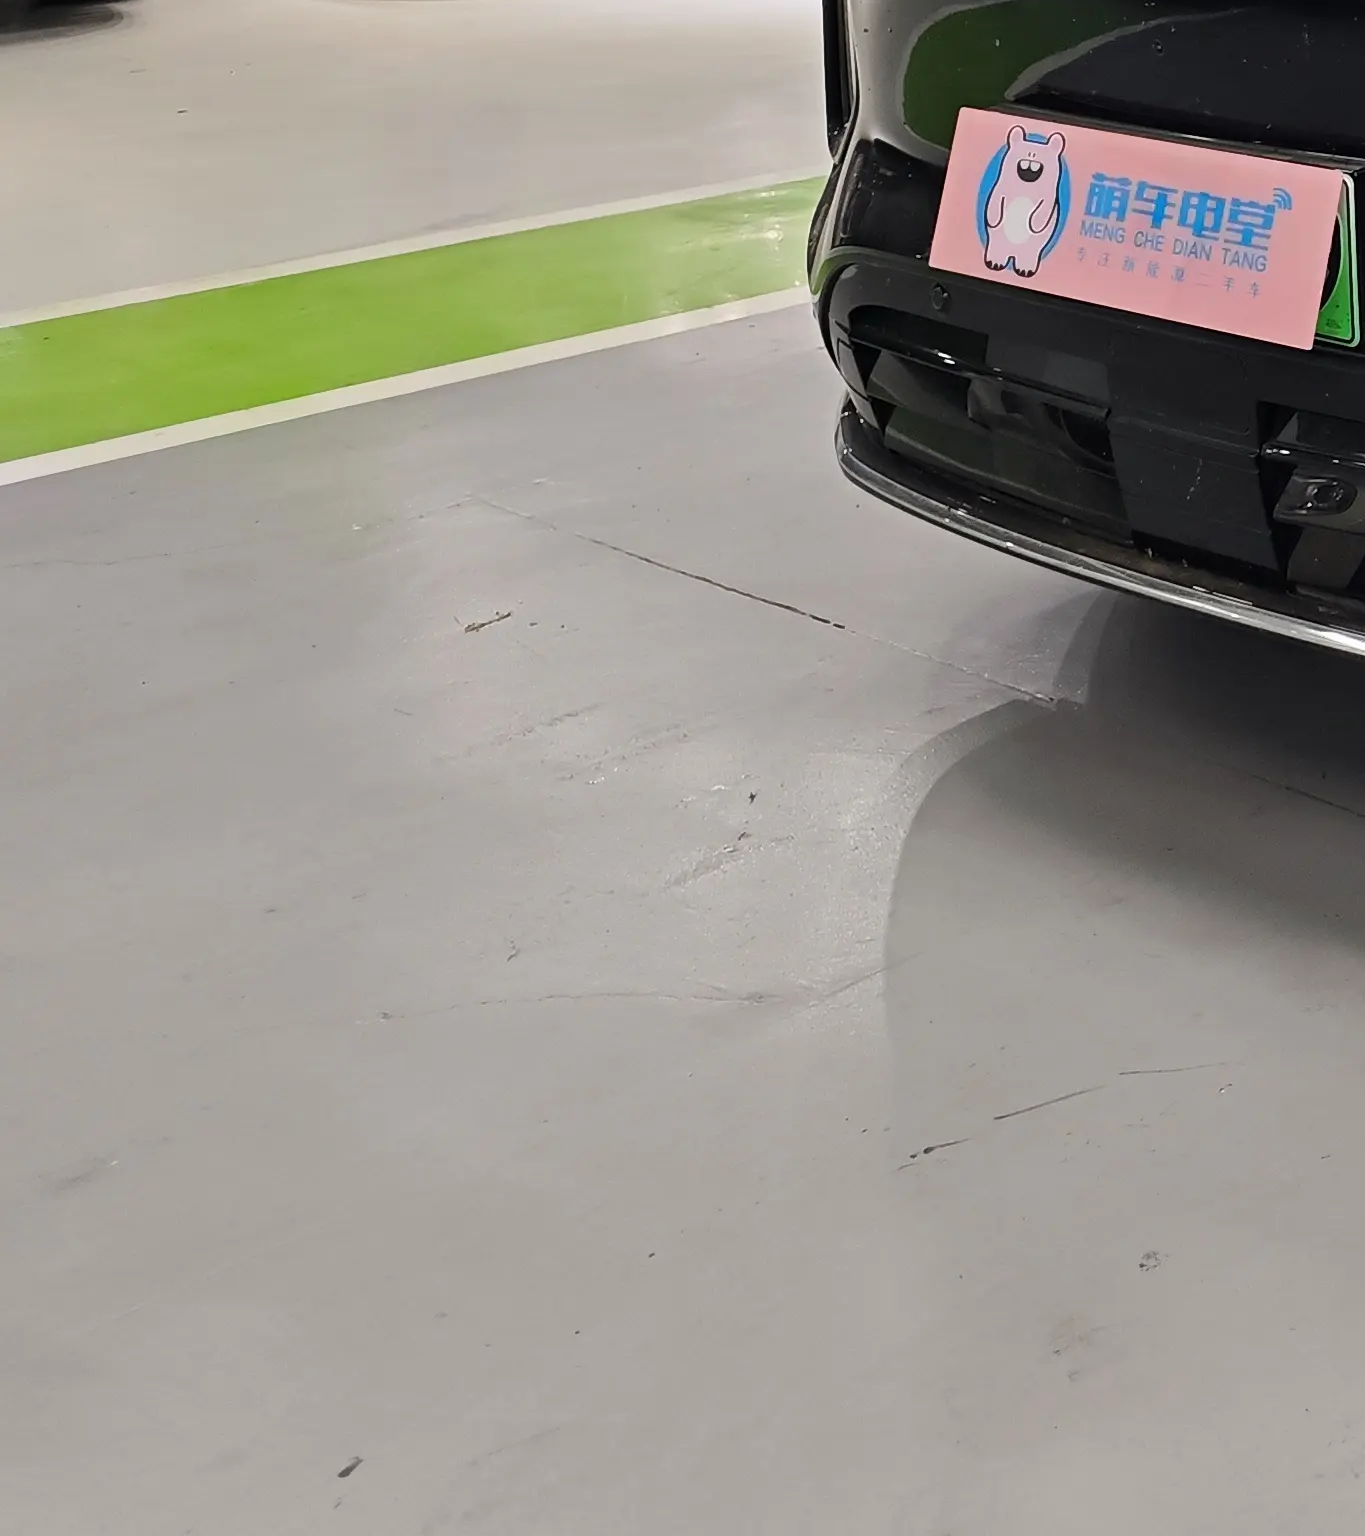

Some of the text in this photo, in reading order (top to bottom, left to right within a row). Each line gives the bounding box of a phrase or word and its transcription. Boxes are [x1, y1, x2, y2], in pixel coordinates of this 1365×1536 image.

[1083, 172, 1276, 251] 萌车电堂
[1079, 220, 1268, 273] MENG CHE DIAN TANG
